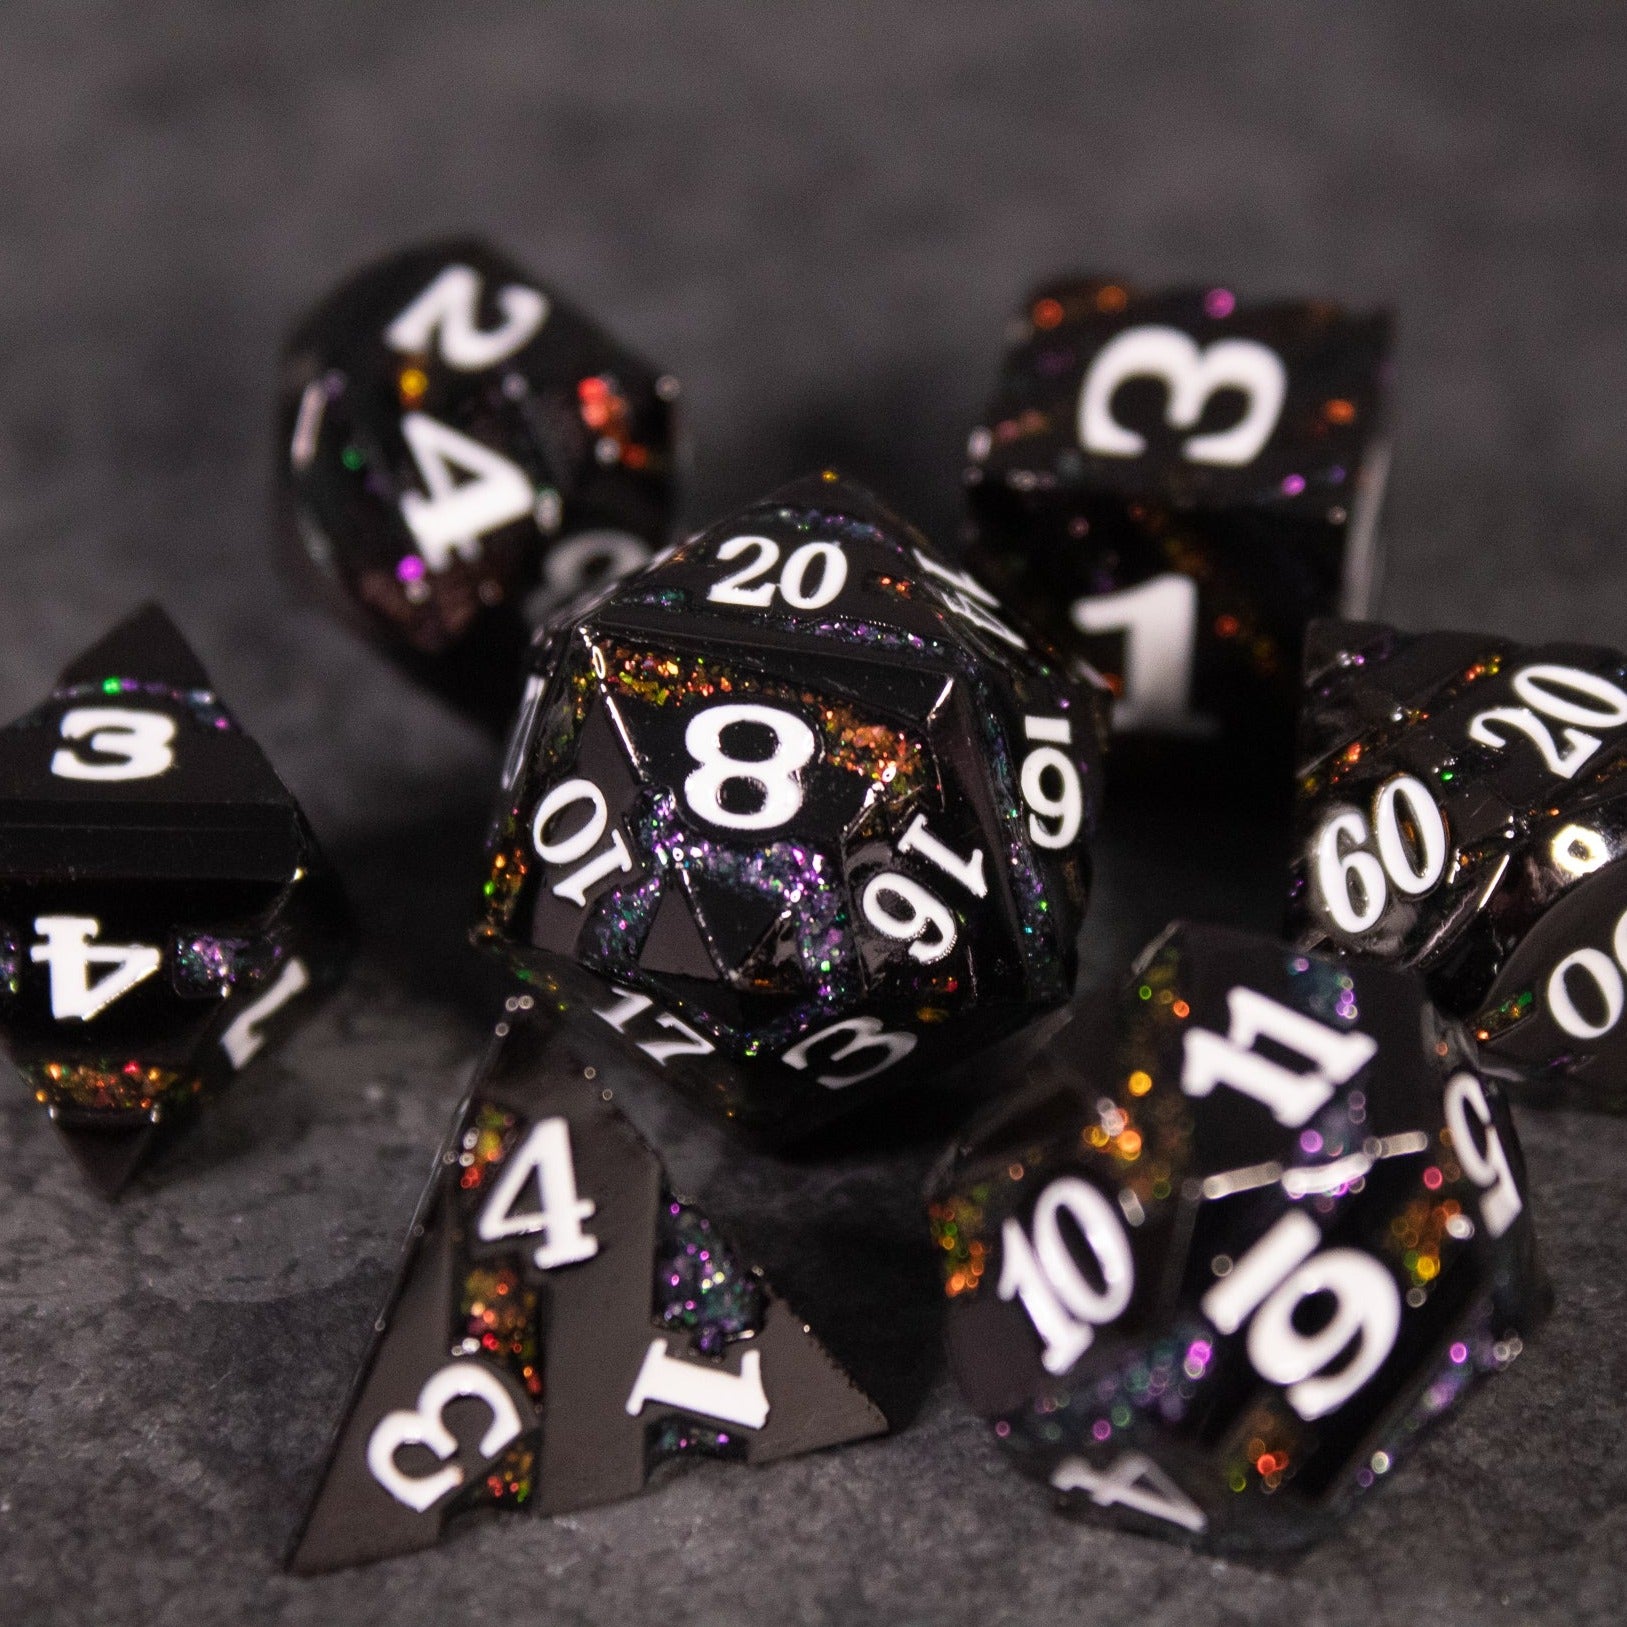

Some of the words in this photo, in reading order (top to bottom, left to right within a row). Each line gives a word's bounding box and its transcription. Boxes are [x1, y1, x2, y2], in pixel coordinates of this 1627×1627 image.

[387, 265, 549, 370] 2
[1078, 326, 1287, 466] 3
[401, 413, 536, 571] 4
[706, 535, 848, 610] 20
[1073, 575, 1214, 735] 1
[51, 708, 176, 782] 3
[684, 704, 816, 831] 8
[1469, 664, 1627, 780] 20
[532, 779, 633, 907] 10
[863, 813, 988, 965] 16
[1312, 773, 1446, 934] 60
[30, 915, 162, 1022] 4
[595, 987, 717, 1066] 17
[783, 1017, 918, 1091] 3
[1182, 986, 1378, 1128] 11
[479, 1117, 599, 1269] 4
[1444, 1074, 1523, 1238] 5
[998, 1179, 1135, 1376] 10
[367, 1362, 522, 1513] 3
[626, 1337, 770, 1430] 1
[1052, 1455, 1208, 1533] 4
